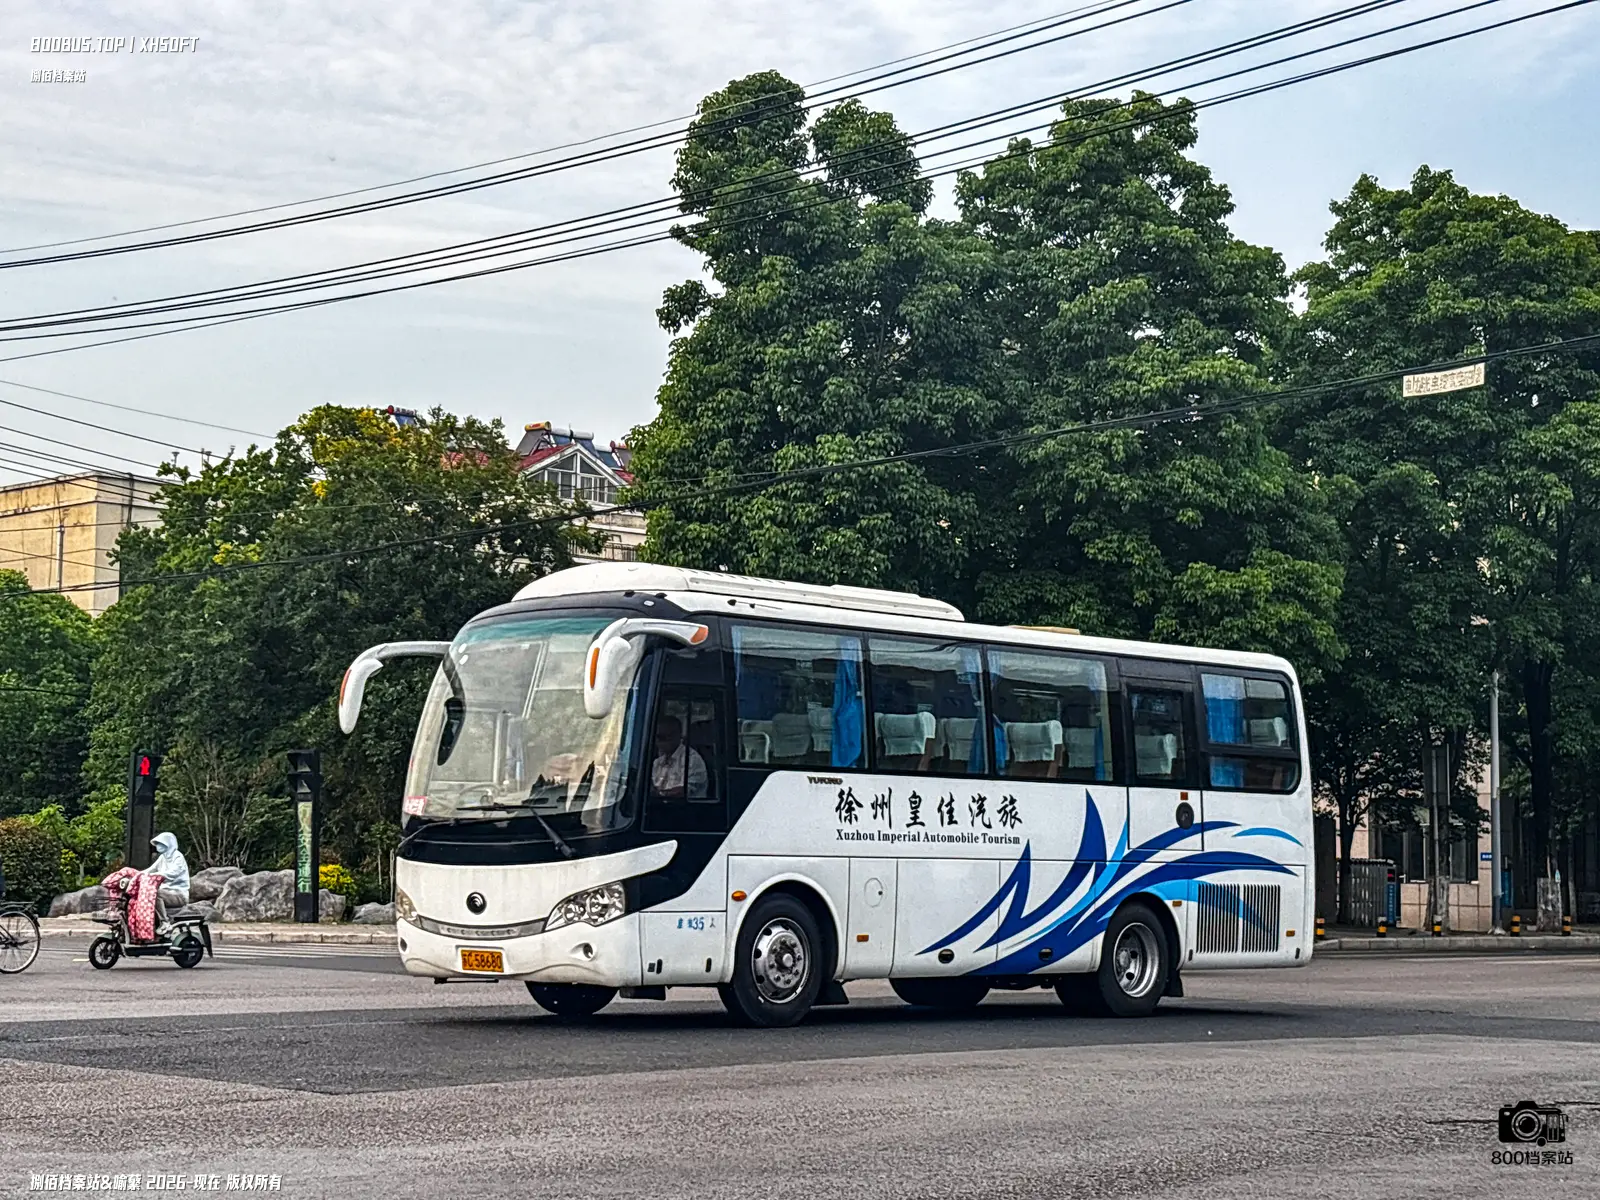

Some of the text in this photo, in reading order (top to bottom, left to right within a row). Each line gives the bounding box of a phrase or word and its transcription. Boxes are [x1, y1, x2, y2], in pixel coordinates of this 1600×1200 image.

[835, 786, 1023, 829] 徐州皇佳汽旅
[836, 828, 1021, 845] Xuzhou Imperial Automobile Tourism
